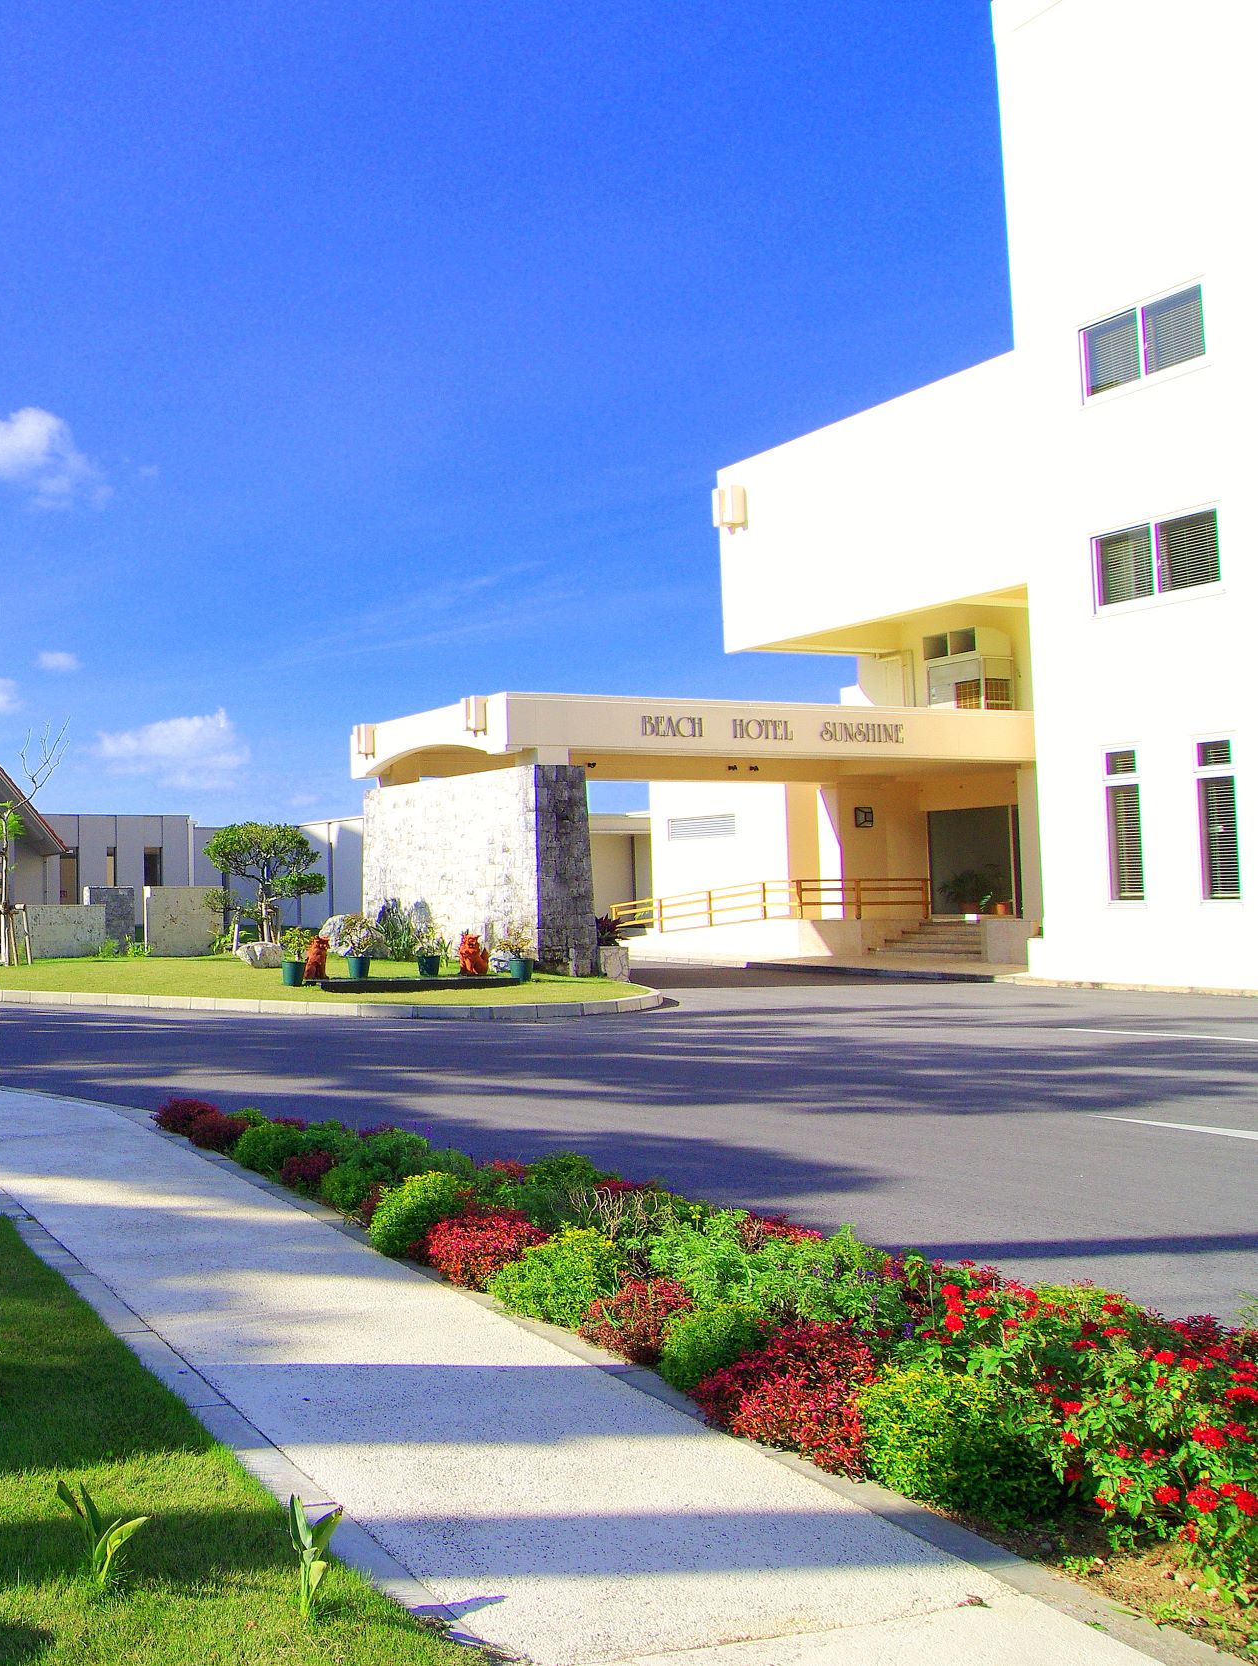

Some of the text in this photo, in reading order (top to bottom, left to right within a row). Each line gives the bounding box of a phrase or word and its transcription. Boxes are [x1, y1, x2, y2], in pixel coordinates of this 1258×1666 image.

[641, 715, 904, 743] BEACH HOTEL SUNSHINE
